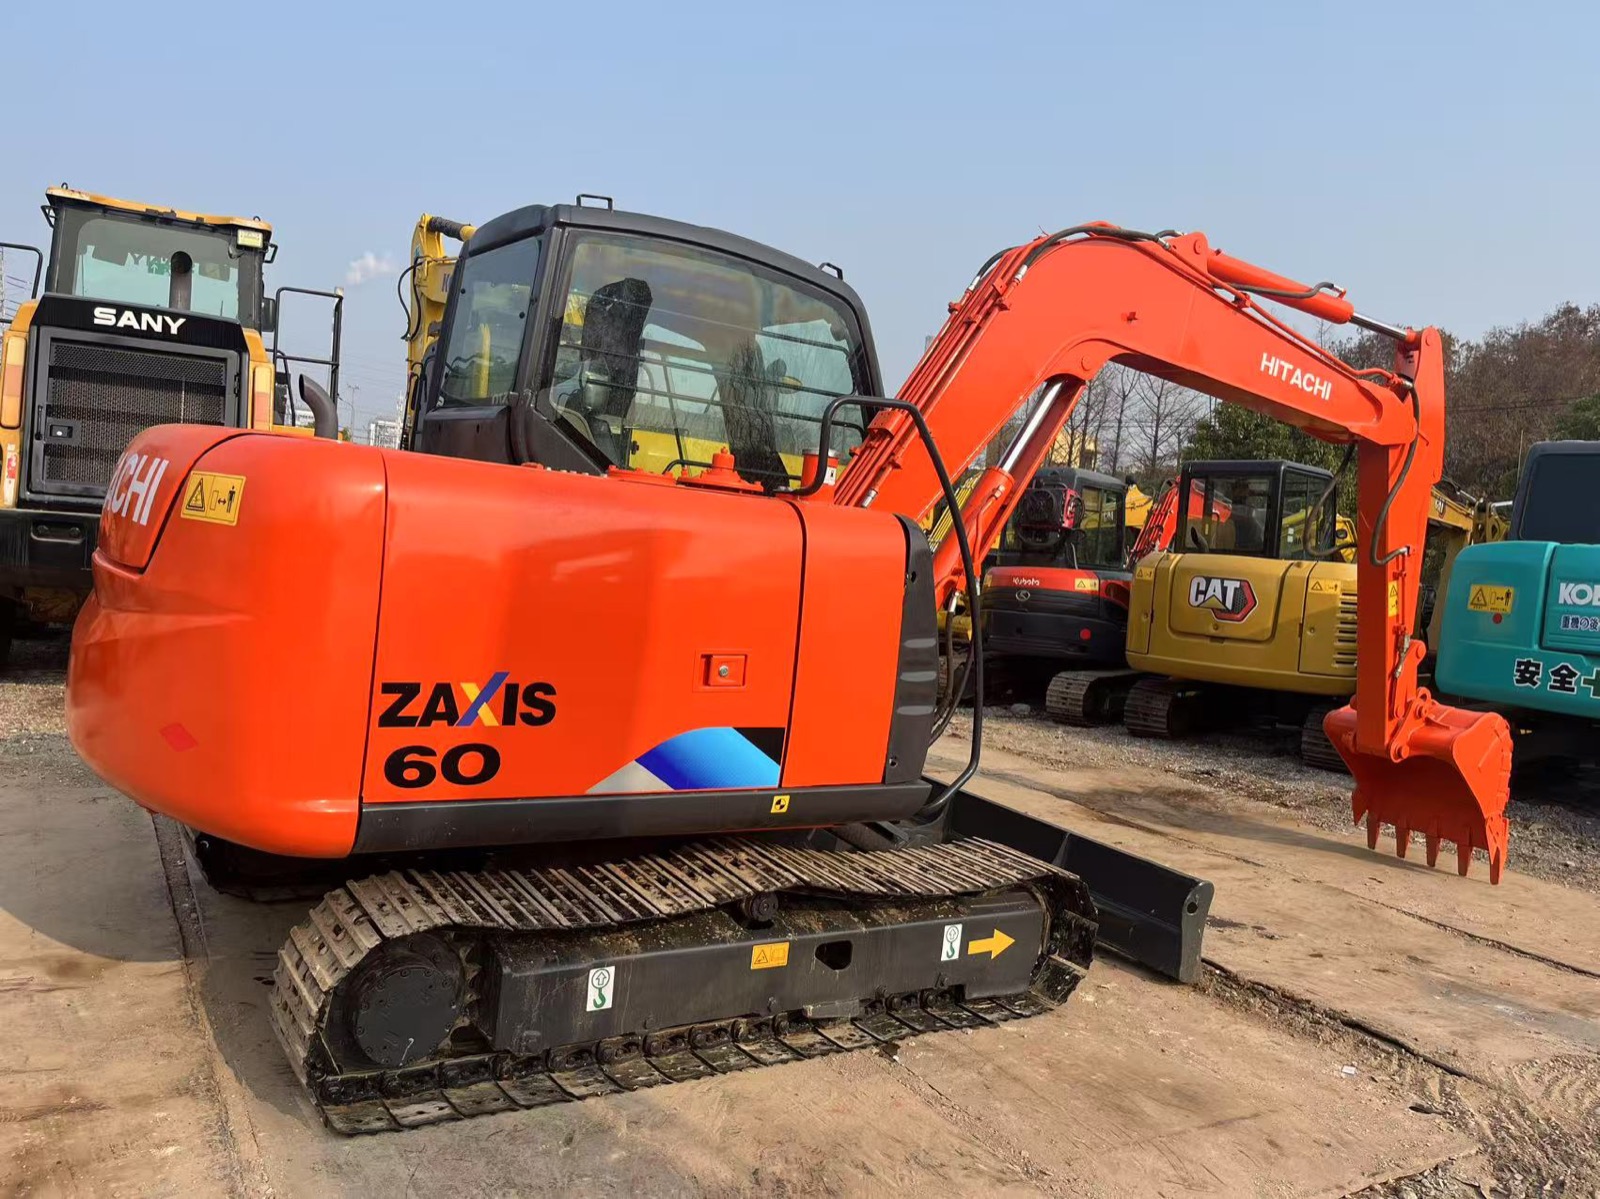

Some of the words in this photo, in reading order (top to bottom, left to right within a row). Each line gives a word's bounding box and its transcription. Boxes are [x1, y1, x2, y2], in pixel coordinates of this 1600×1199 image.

[93, 307, 186, 335] SANY
[1260, 352, 1332, 401] HITACHI
[1012, 576, 1040, 586] Kubota
[1189, 576, 1240, 611] CAT
[1513, 658, 1580, 694] 安全
[377, 672, 557, 728] ZAXIS
[383, 743, 501, 789] 60
